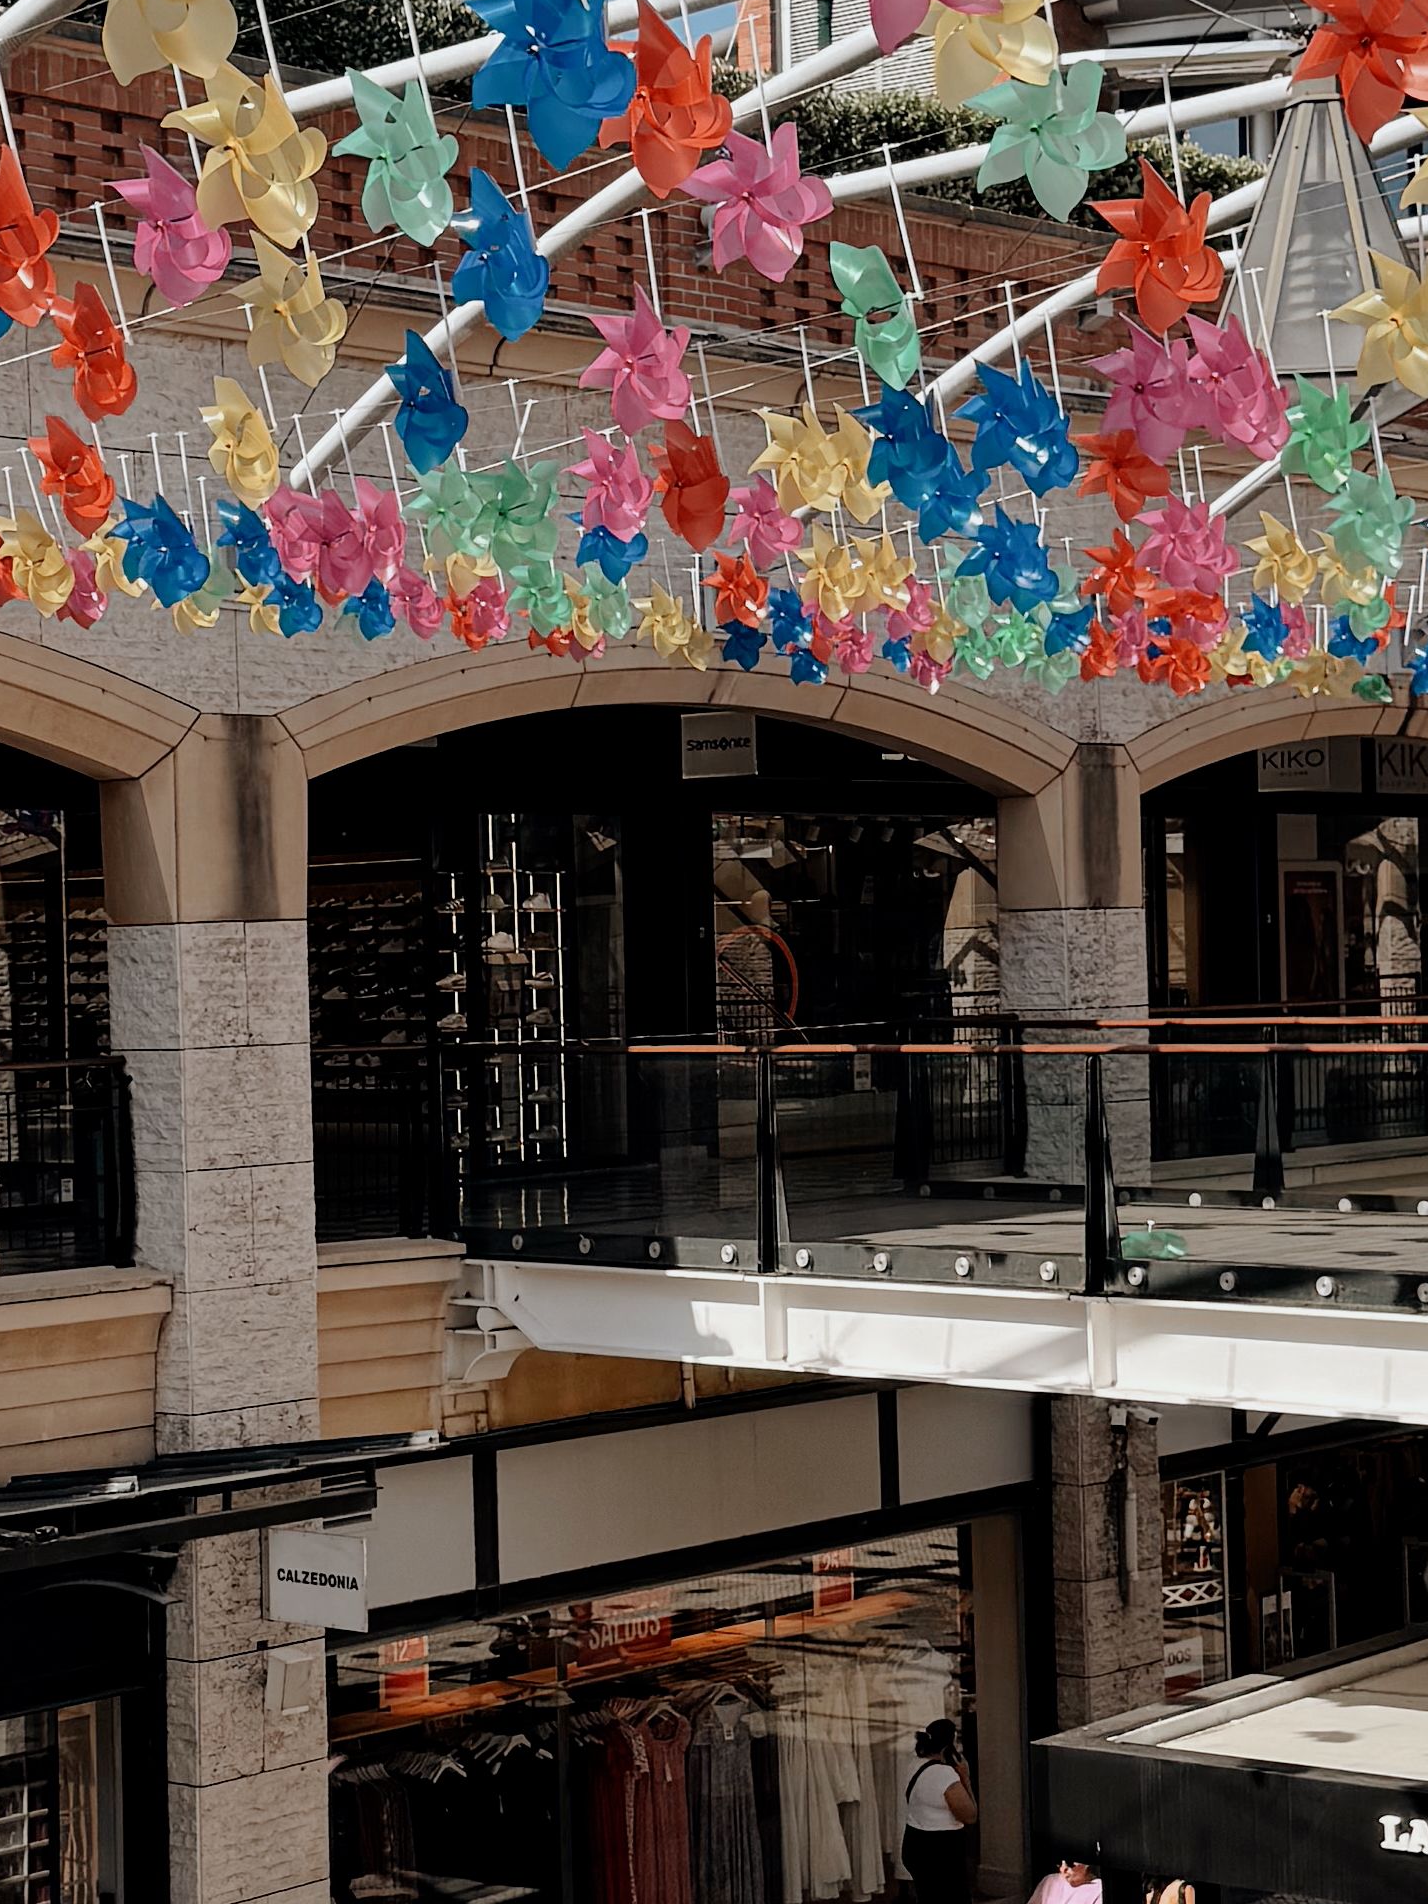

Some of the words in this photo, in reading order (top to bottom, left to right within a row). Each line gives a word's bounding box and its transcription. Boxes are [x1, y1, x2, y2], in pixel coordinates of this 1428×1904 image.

[1262, 748, 1325, 770] KIKO
[276, 1567, 360, 1591] CALZEDONIA
[588, 1615, 662, 1651] SALDOS
